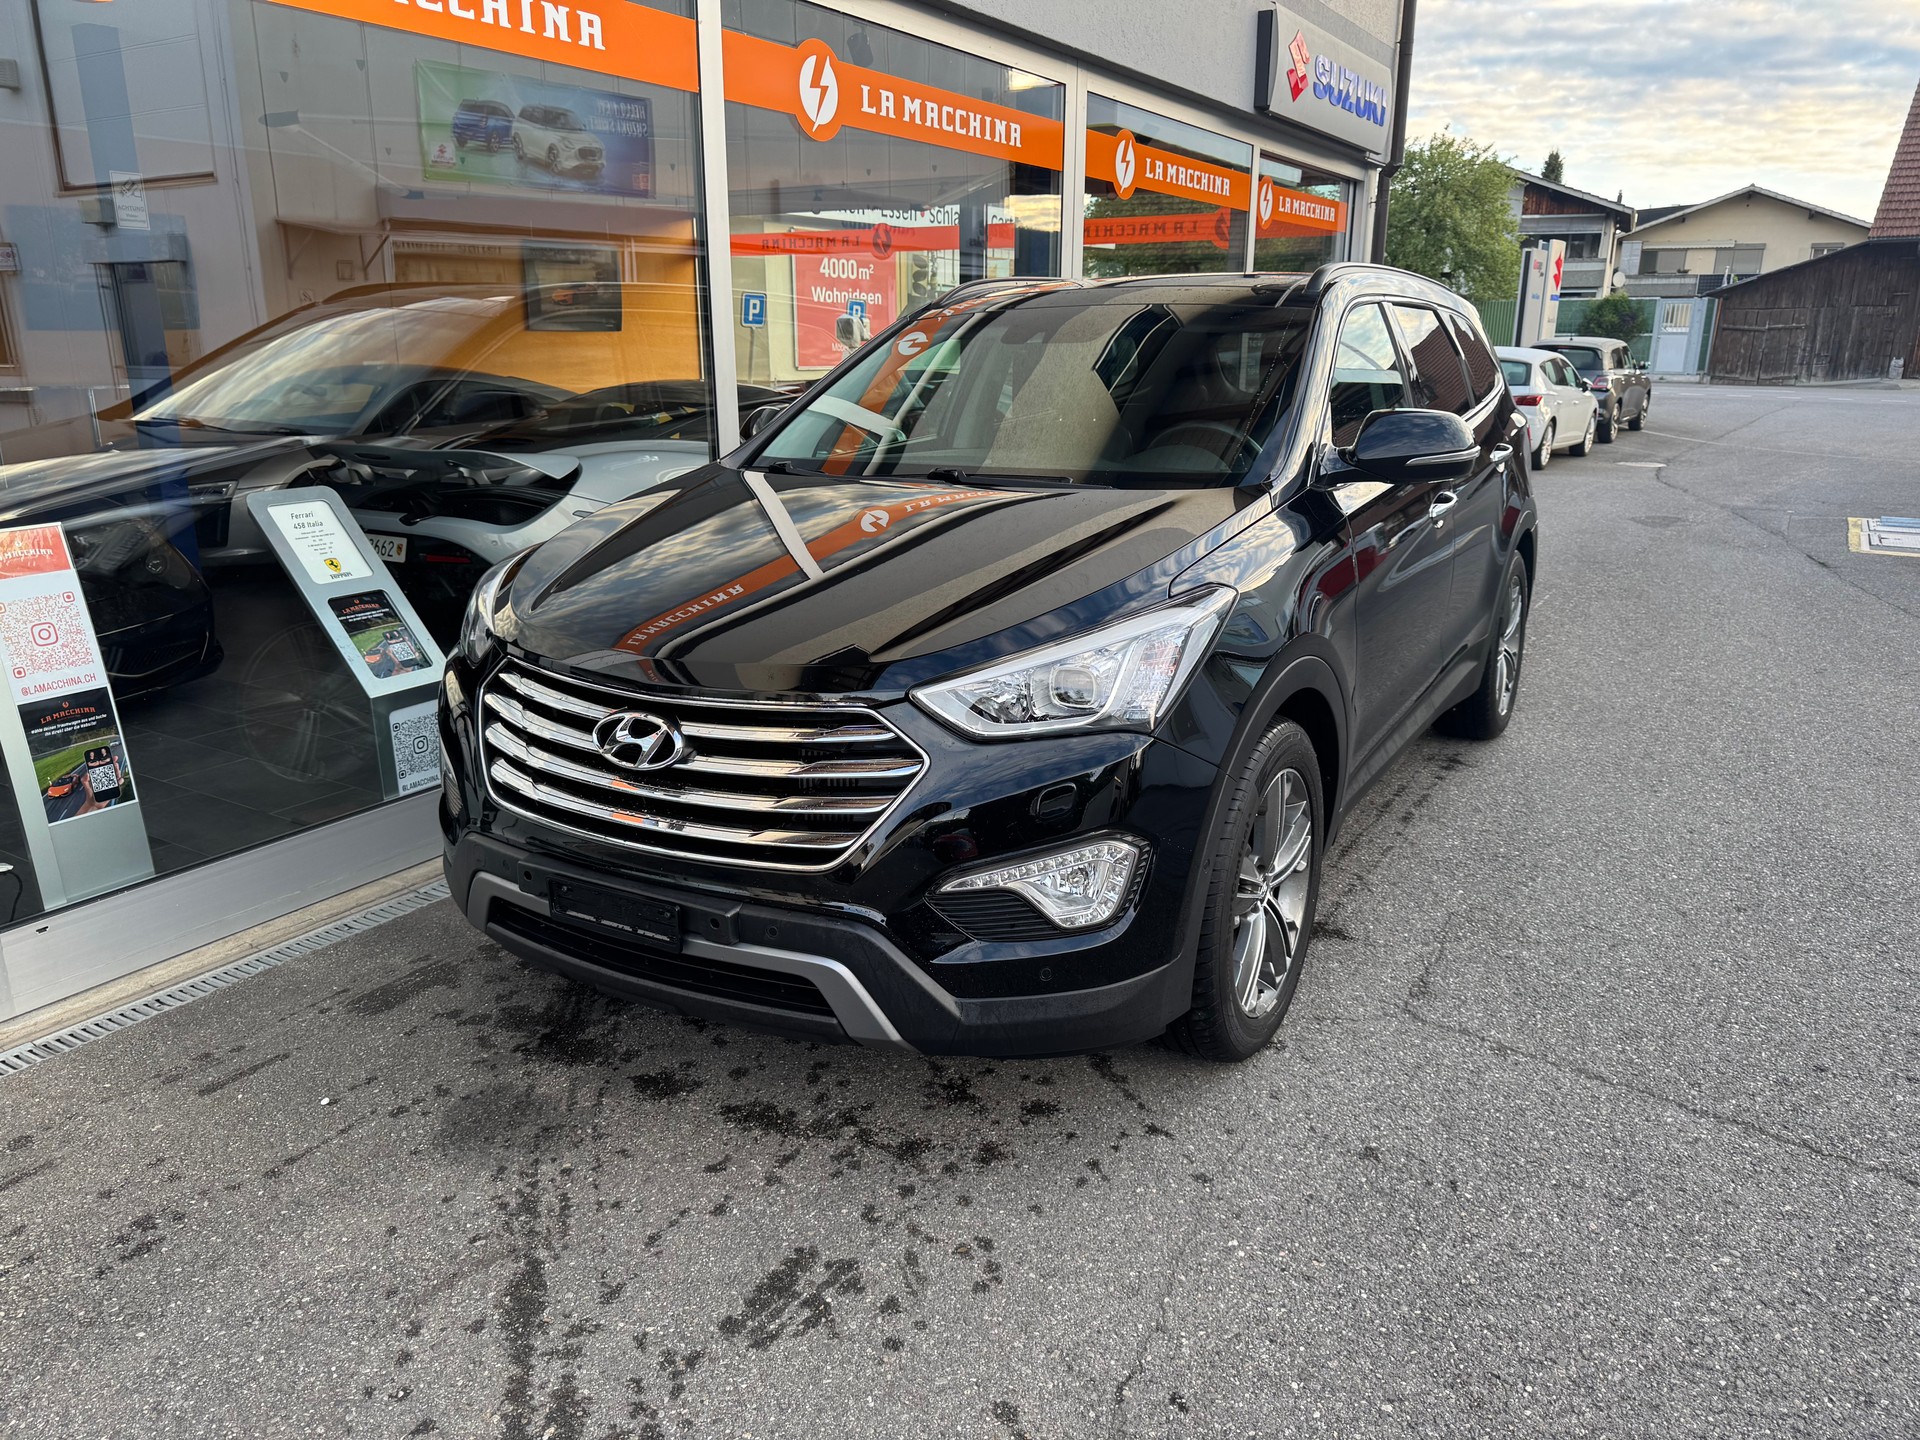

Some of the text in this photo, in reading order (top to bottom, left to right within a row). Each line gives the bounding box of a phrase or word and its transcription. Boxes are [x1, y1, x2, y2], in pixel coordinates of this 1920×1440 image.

[1313, 54, 1386, 127] SUZUKI
[860, 84, 1022, 148] LA MACCHINA
[1145, 158, 1231, 197] LA MACCHINA
[1278, 195, 1336, 222] LA MACCHINA
[819, 257, 857, 280] 4000
[811, 286, 882, 305] Wohnideen
[749, 299, 760, 322] P
[290, 511, 314, 520] Ferrari
[306, 520, 324, 528] Italia
[21, 673, 97, 696] @LAMACCHINA.CH
[40, 715, 52, 725] LA
[53, 706, 97, 719] MACCHINA
